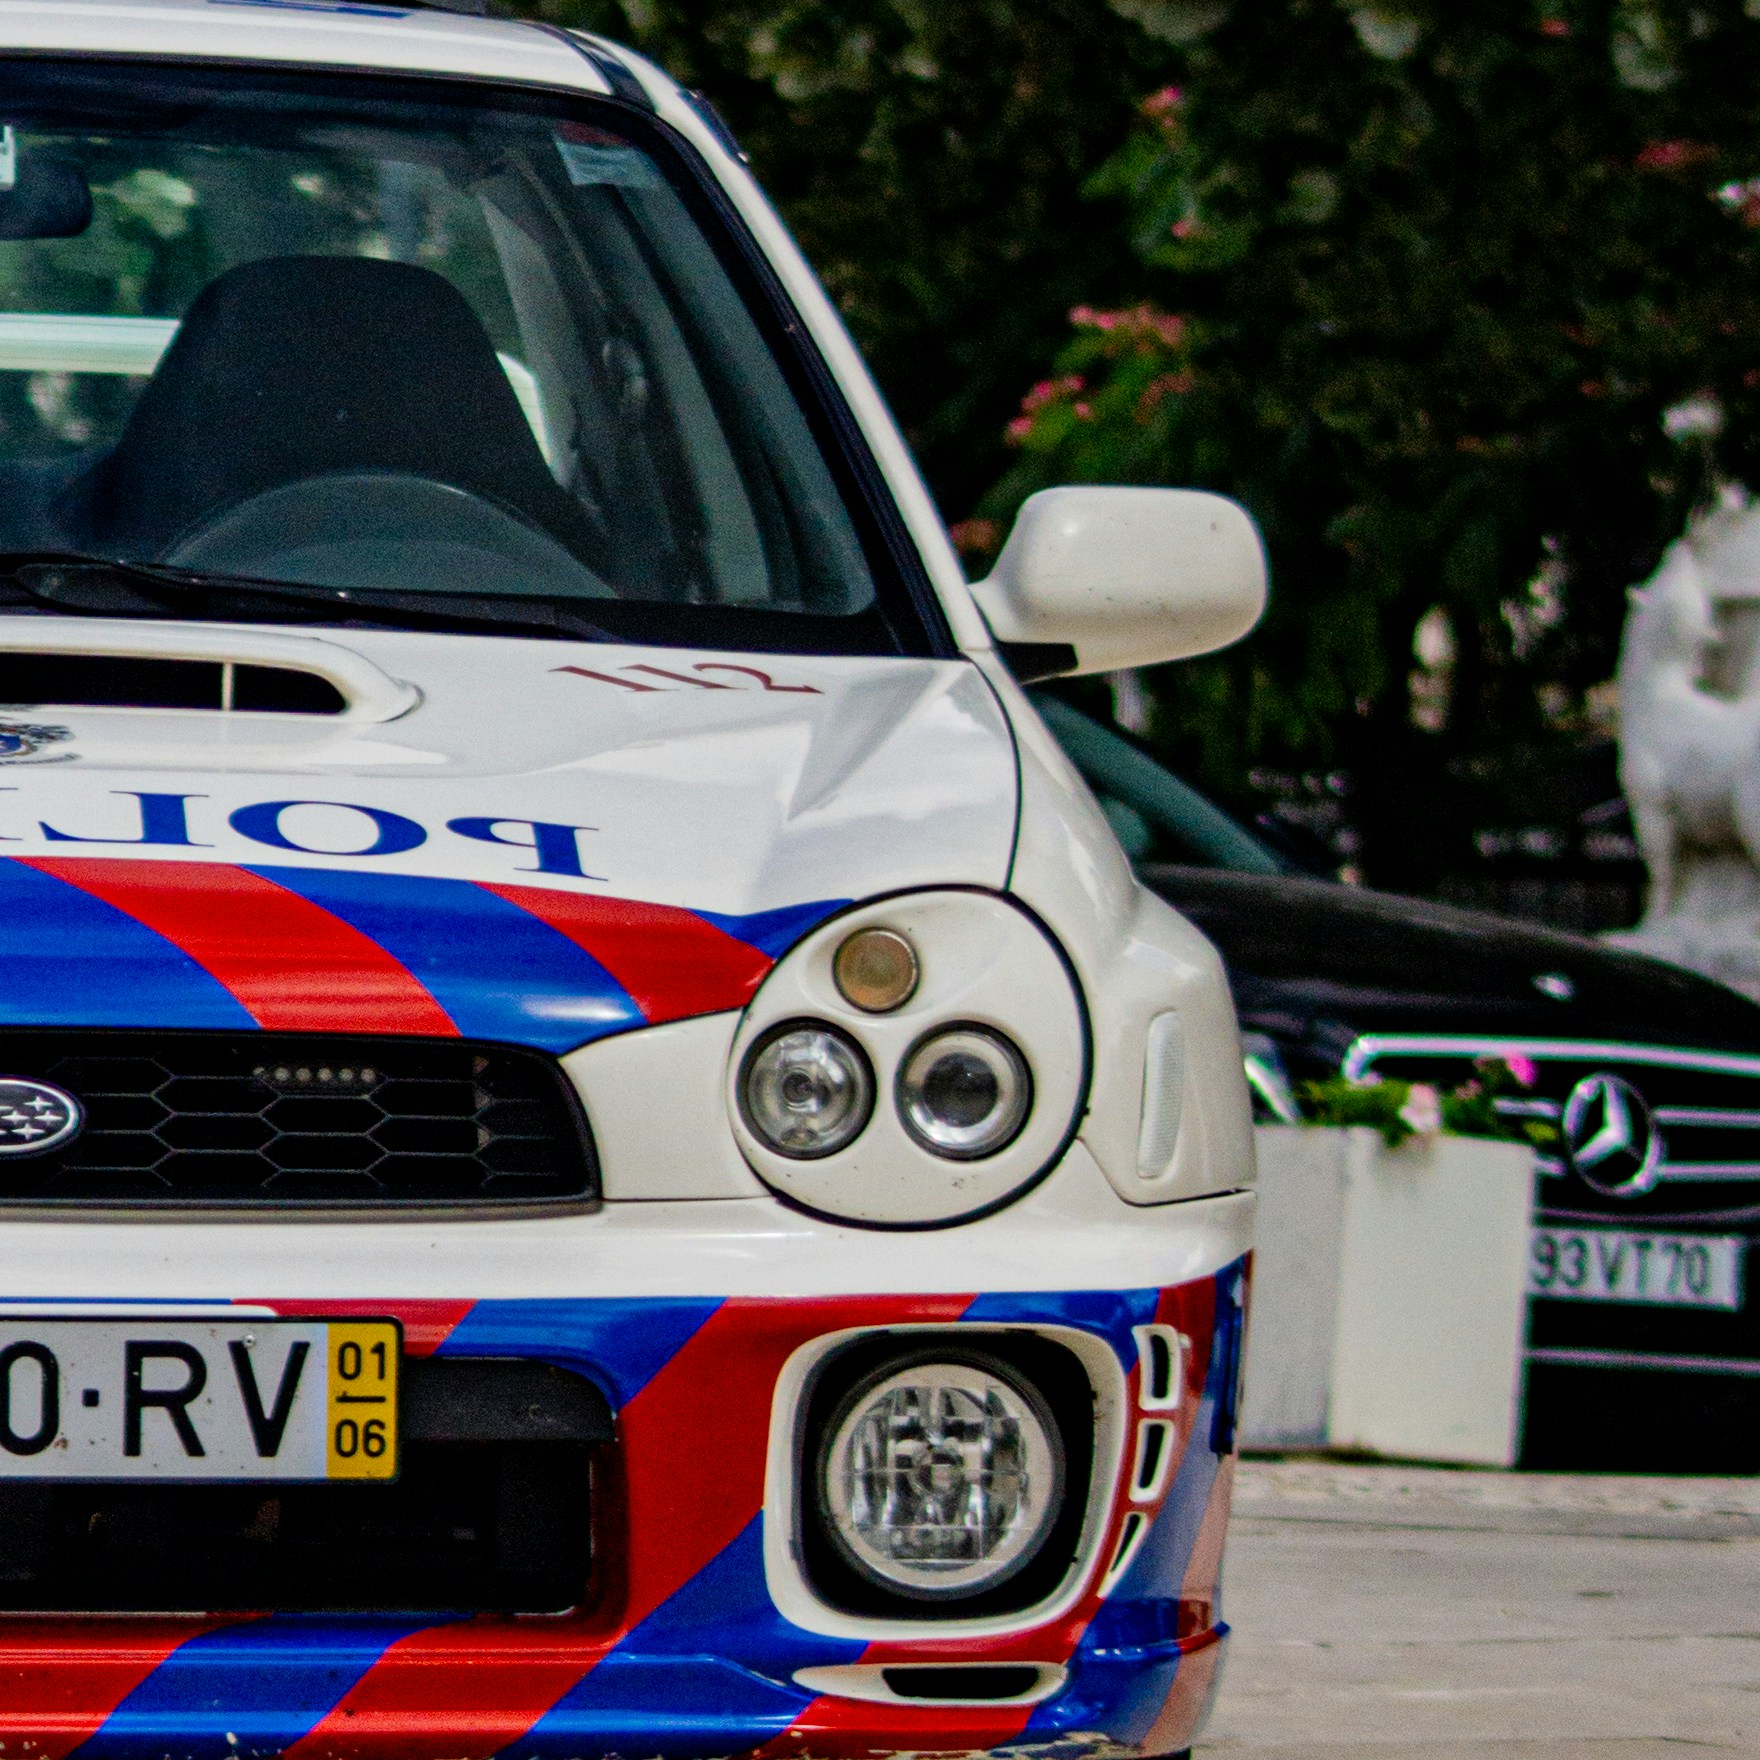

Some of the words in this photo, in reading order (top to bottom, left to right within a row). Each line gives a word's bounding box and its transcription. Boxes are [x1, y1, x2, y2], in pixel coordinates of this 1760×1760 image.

[548, 662, 826, 695] 112
[335, 1340, 388, 1382] 01
[333, 1418, 388, 1459] 06
